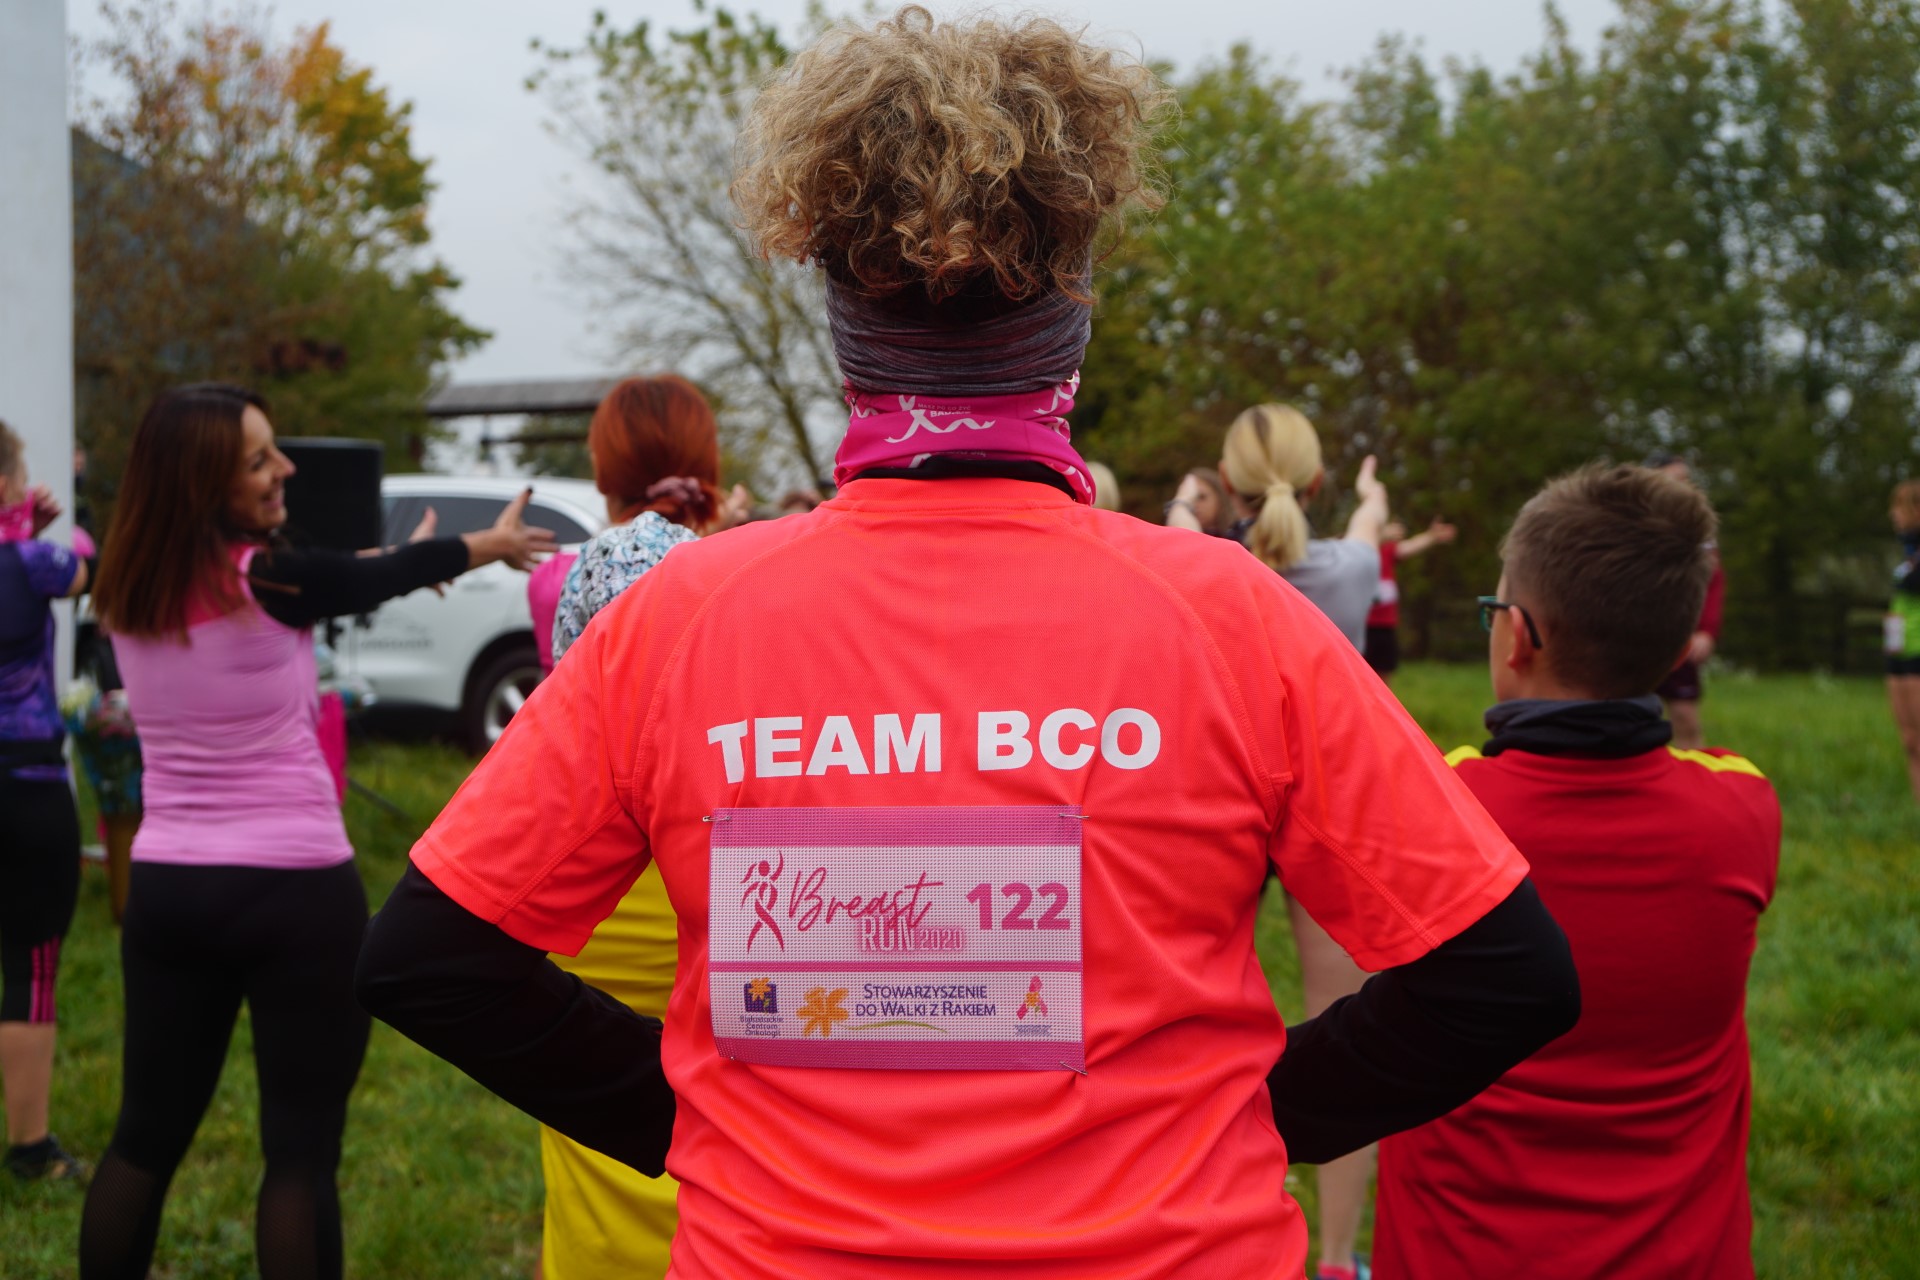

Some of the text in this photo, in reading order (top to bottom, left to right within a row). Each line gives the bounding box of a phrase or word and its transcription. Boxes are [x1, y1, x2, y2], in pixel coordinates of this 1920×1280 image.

[708, 707, 1161, 784] TEAM BCO
[788, 866, 944, 932] Breast
[967, 882, 1071, 931] 122
[861, 916, 965, 951] RUN 2020
[855, 1000, 996, 1017] DO WALKI Z RAKIEM
[863, 983, 988, 999] STOWARZYSZENIE
